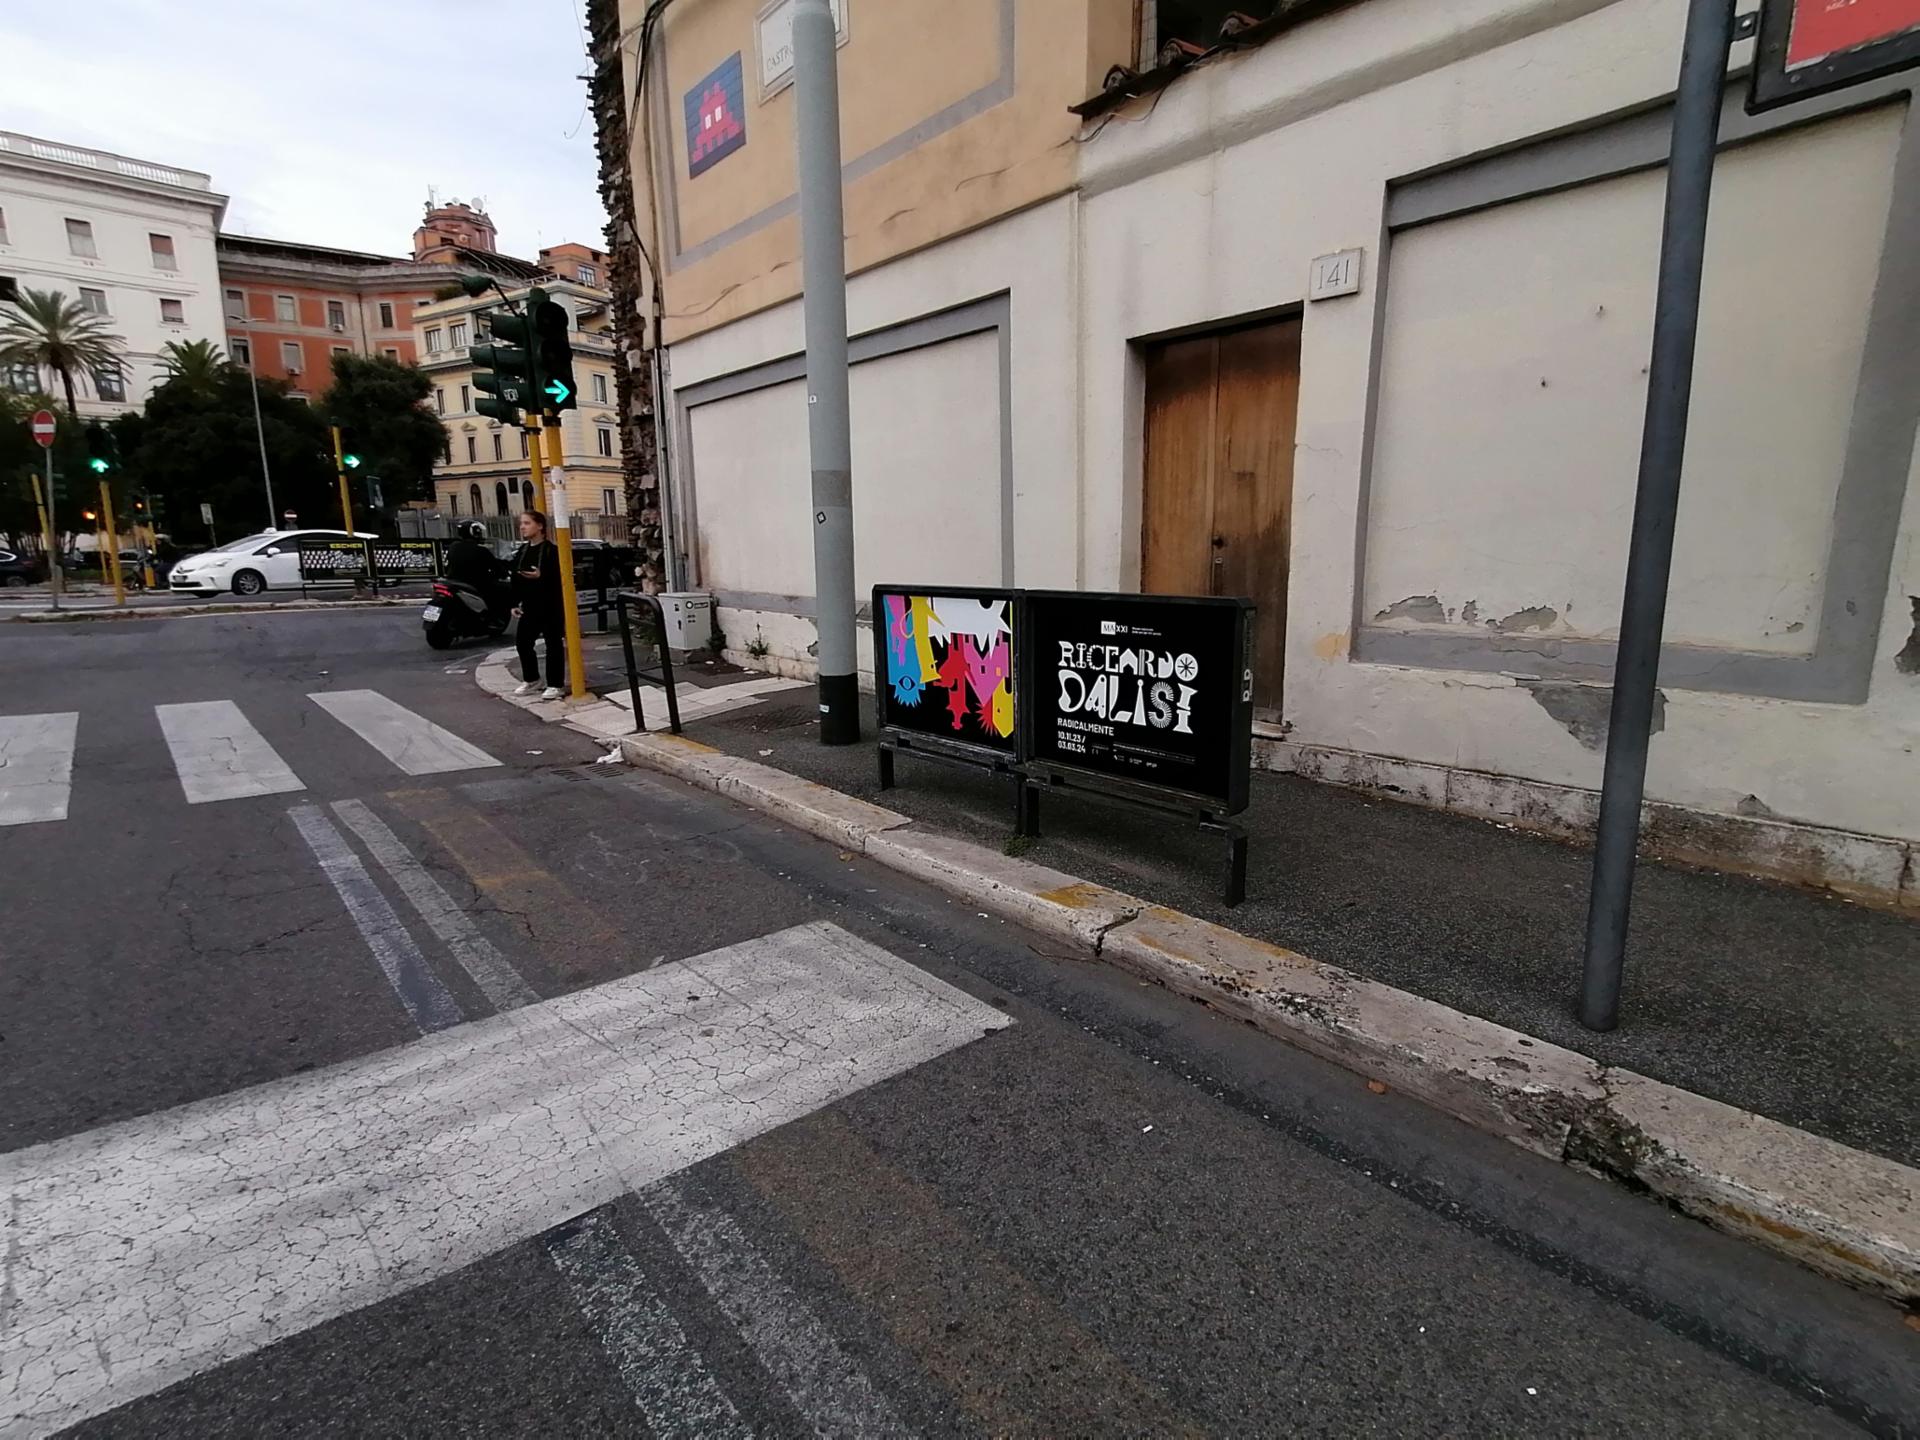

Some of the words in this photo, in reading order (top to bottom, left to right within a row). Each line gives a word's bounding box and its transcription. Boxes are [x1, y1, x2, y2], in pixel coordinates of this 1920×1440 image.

[1317, 259, 1349, 290] 141
[1102, 622, 1128, 634] MAXXI
[1058, 640, 1199, 682] RICCARDO
[1058, 669, 1198, 734] DALISI
[1057, 717, 1115, 737] RADICALMENTE
[1057, 740, 1086, 753] 03.03.24
